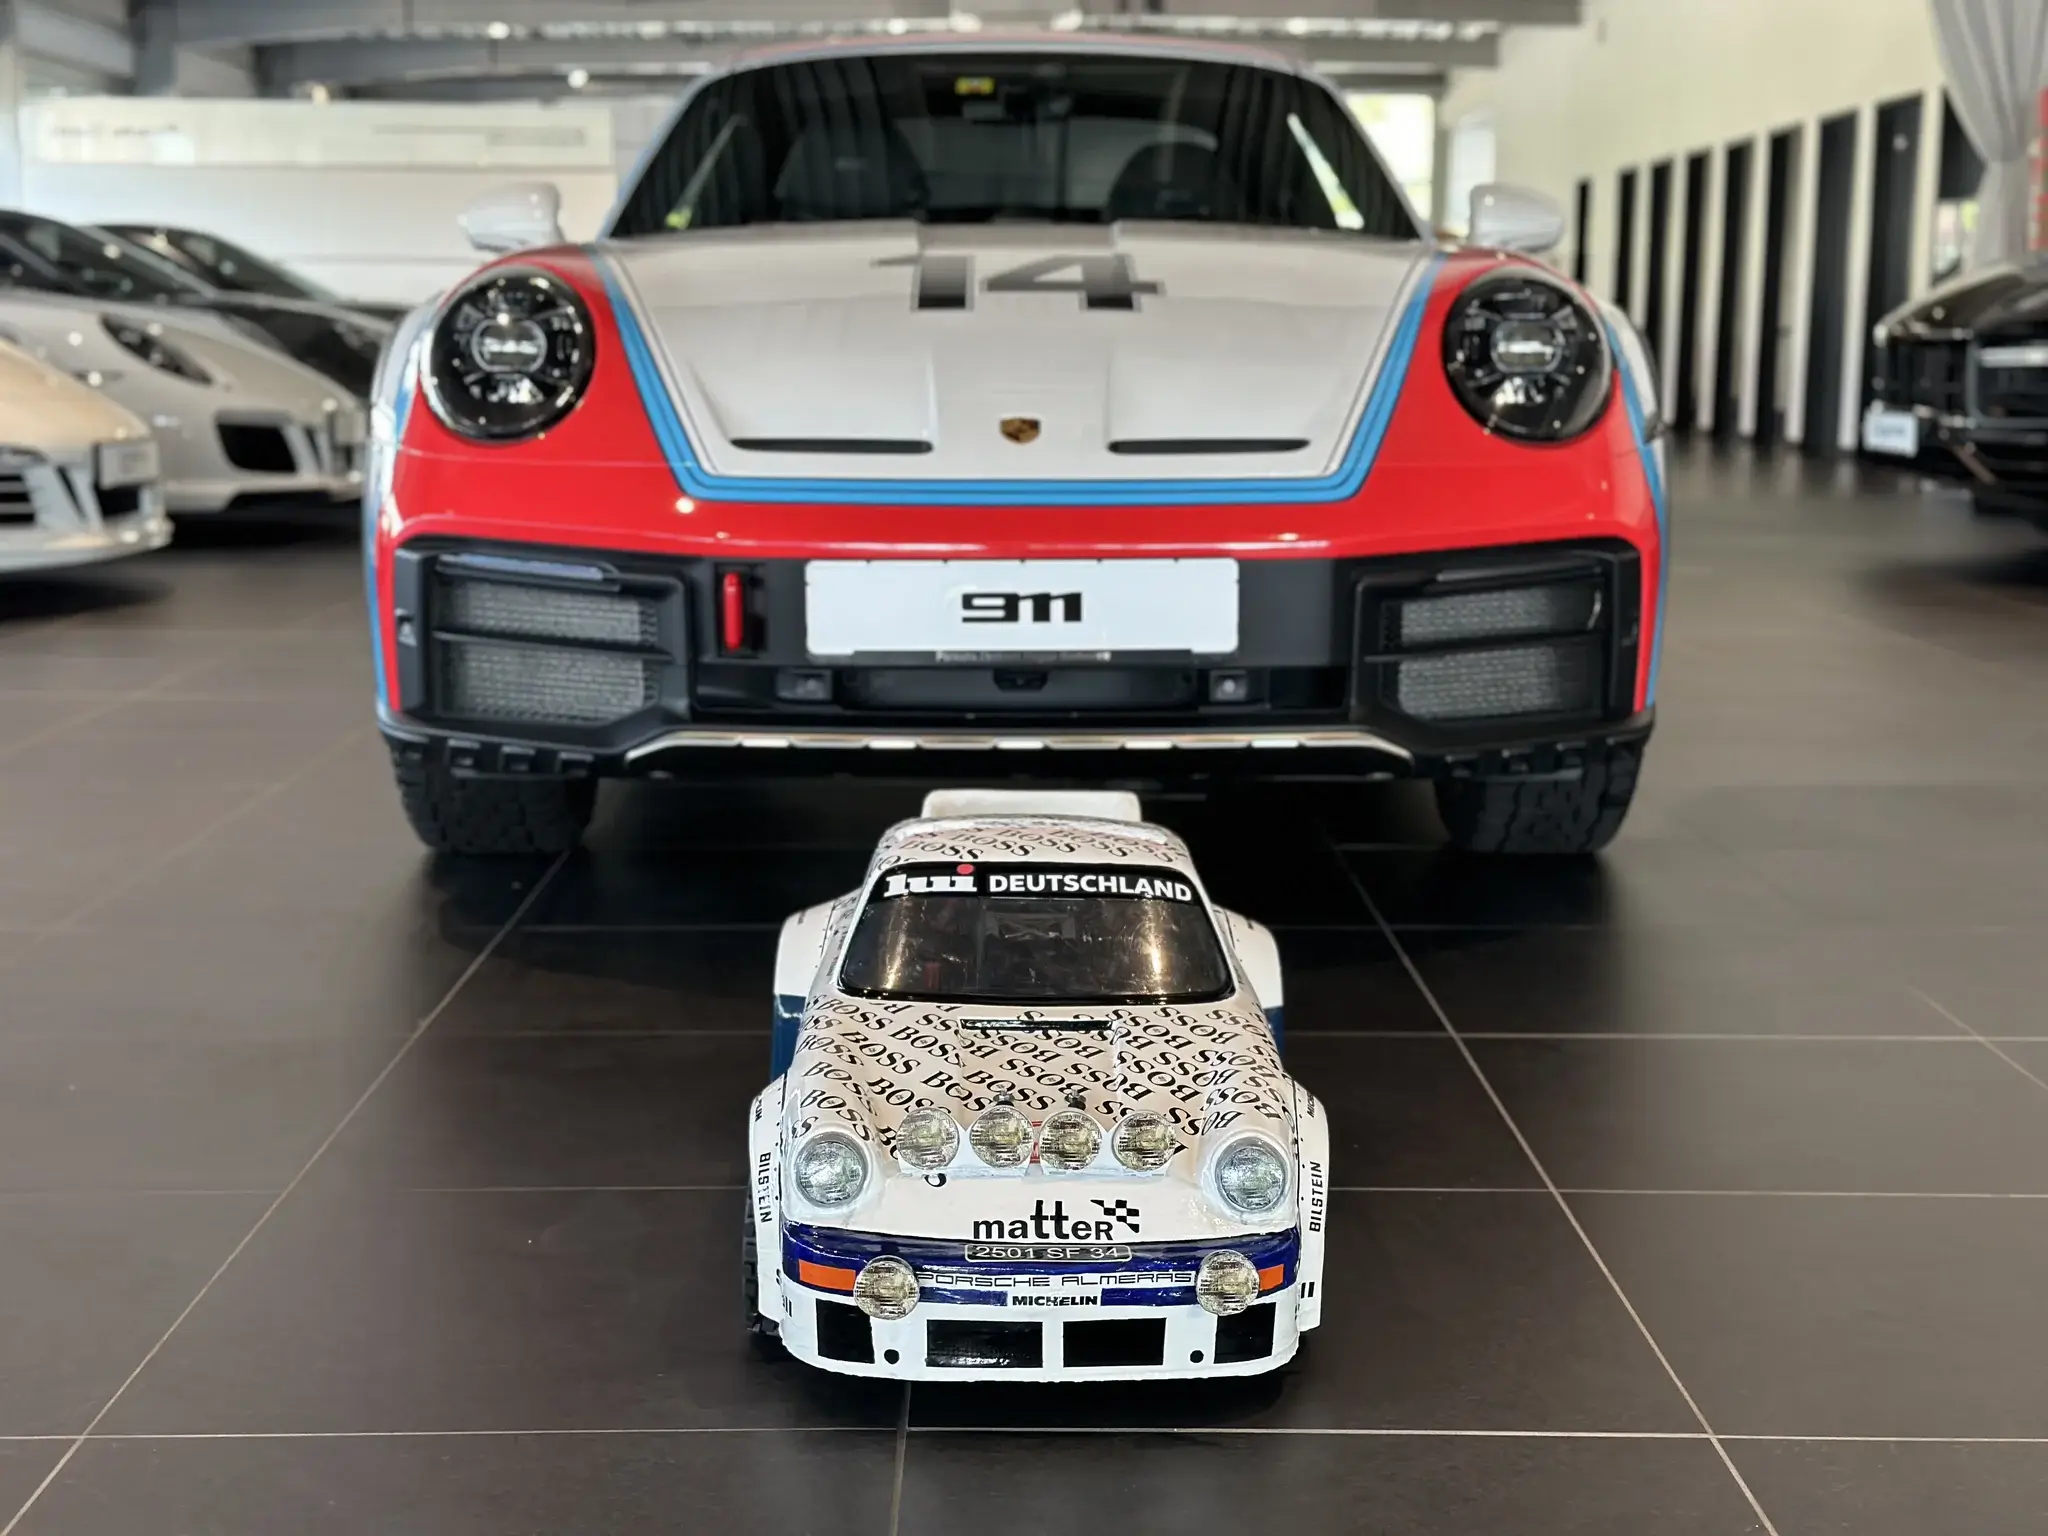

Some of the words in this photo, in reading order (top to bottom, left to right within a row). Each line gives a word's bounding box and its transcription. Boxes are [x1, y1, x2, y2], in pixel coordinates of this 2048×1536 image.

[870, 253, 1166, 312] 14
[961, 591, 1083, 623] 911
[899, 840, 984, 860] BOSS
[948, 833, 1036, 857] BOSS
[989, 874, 1192, 901] DEUTSCHLAND
[816, 998, 893, 1031] BOSS
[1105, 1008, 1196, 1050] BOSS
[1153, 1006, 1243, 1045] BOSS
[796, 1034, 865, 1067] BOSS
[838, 1030, 921, 1075] BOSS
[888, 1025, 967, 1068] BOSS
[1191, 1049, 1280, 1080] BOSS
[1152, 1051, 1243, 1088] BOSS
[802, 1061, 878, 1117] BOSS
[963, 1069, 1056, 1111] BOSS
[800, 1089, 875, 1142] BOSS
[757, 1152, 773, 1224] BILSTEIN
[1309, 1160, 1324, 1233] BILSTEIN
[975, 1246, 1036, 1259] 2501
[1046, 1246, 1081, 1259] SF
[1090, 1246, 1119, 1259] 34
[916, 1271, 1050, 1288] PORSCHE
[1061, 1272, 1192, 1287] ALMERAS
[1011, 1295, 1098, 1307] MICHELIN
